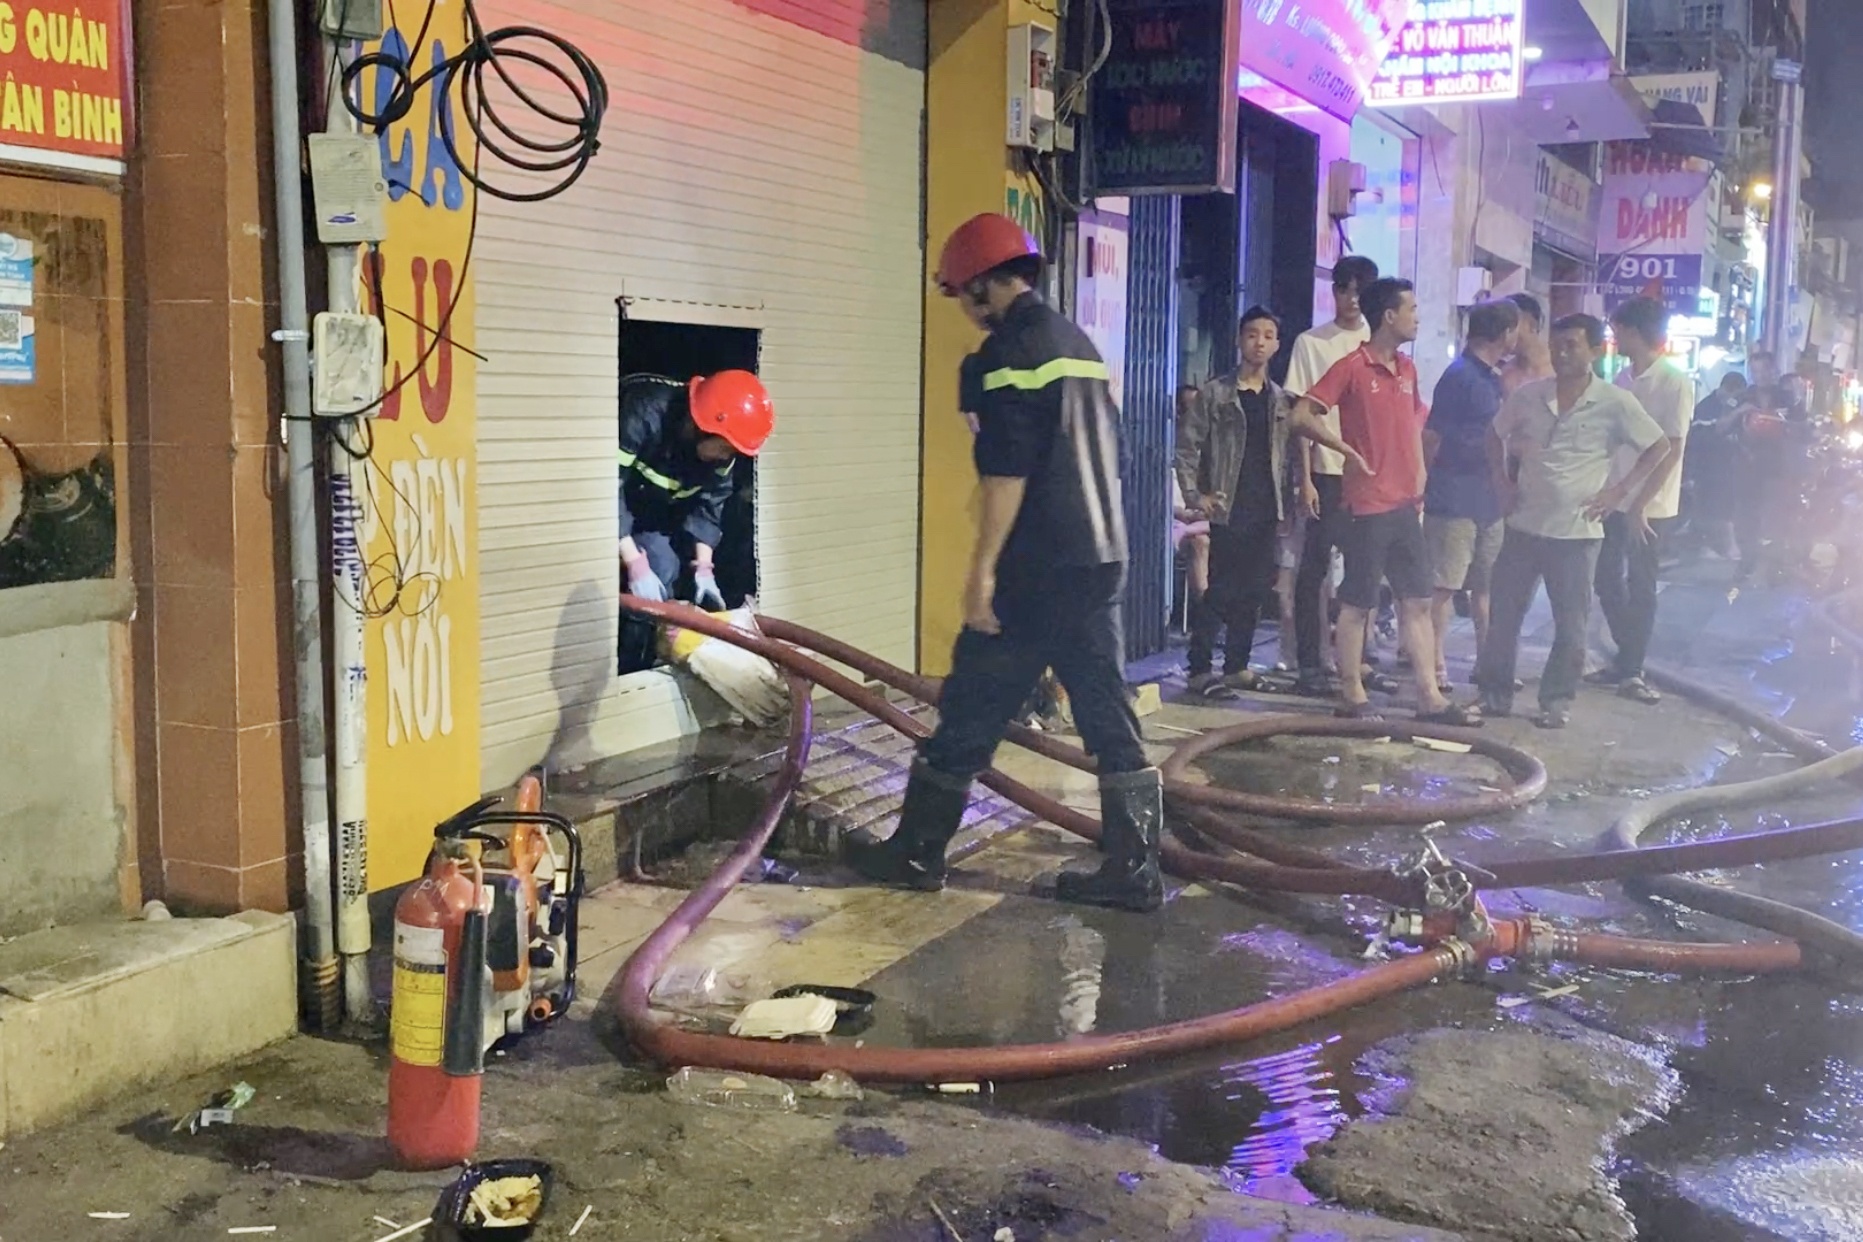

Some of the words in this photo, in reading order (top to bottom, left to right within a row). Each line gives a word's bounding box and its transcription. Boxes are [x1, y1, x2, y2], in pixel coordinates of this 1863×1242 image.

[26, 7, 108, 71] QUÂN
[1427, 20, 1460, 50] VĂN
[53, 79, 123, 145] BÌNH
[1620, 257, 1677, 279] 901
